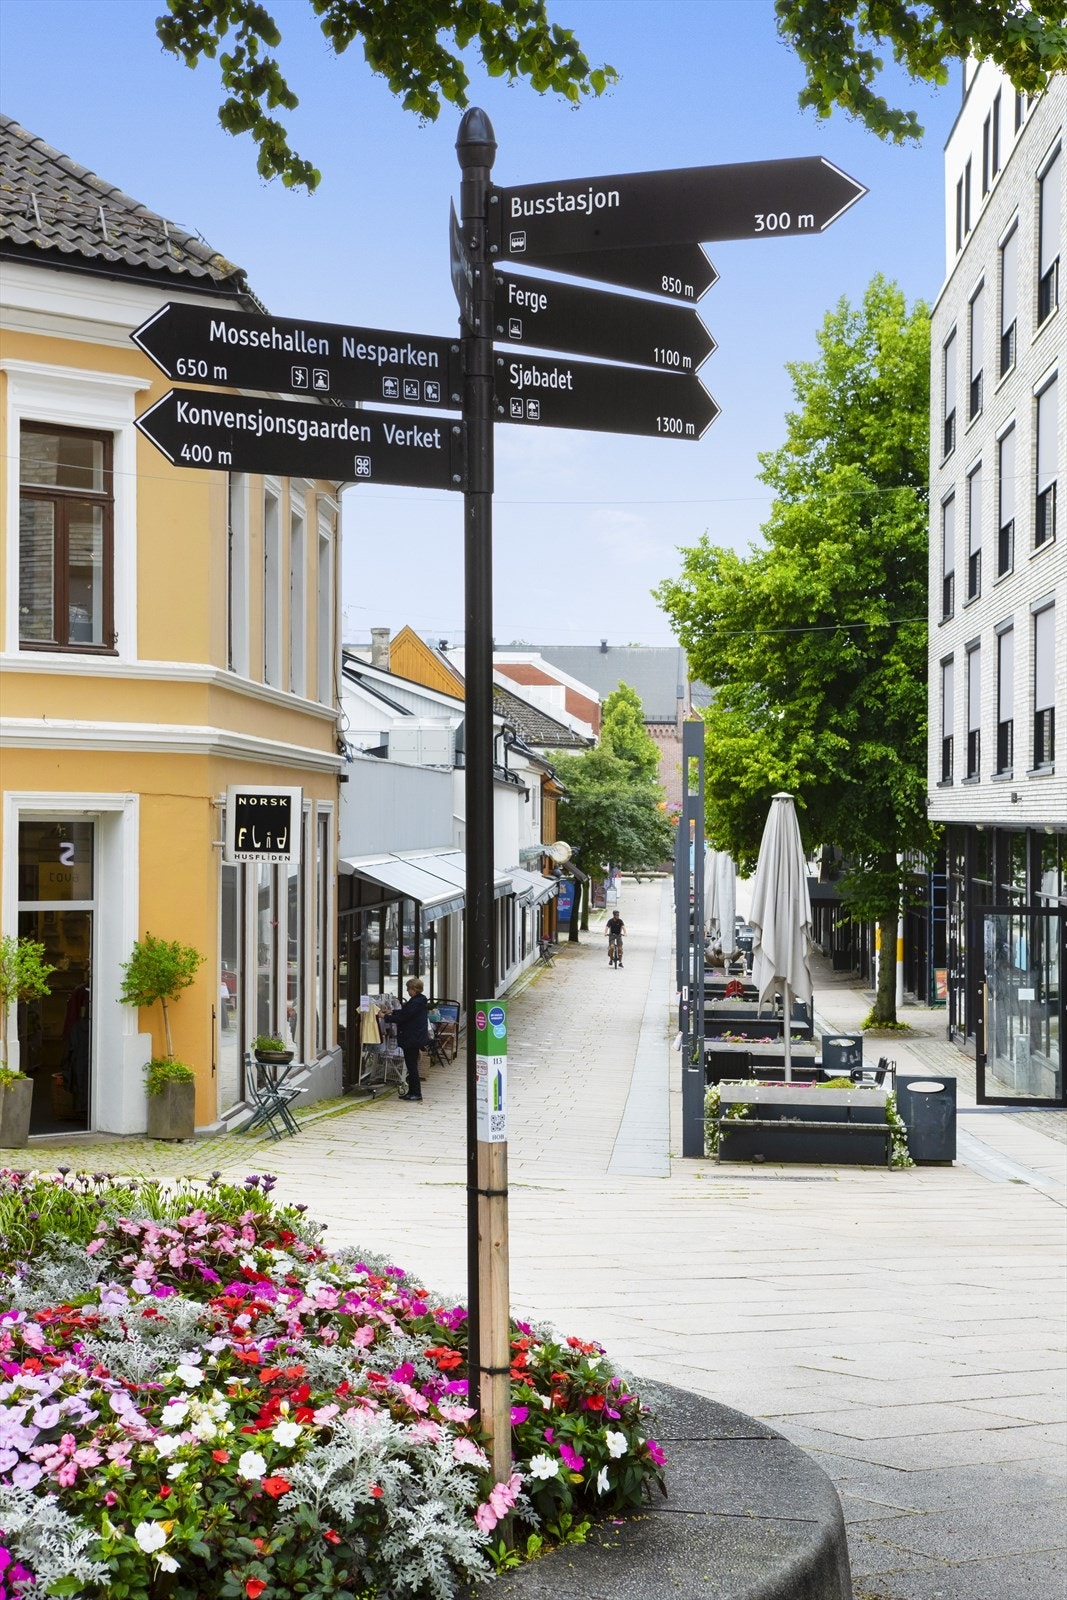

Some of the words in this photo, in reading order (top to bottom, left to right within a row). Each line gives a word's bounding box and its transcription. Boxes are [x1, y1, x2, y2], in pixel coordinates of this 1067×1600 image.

[510, 188, 620, 217] Busstasjon
[754, 212, 791, 232] 300
[798, 213, 815, 228] m
[661, 275, 682, 294] 850
[684, 284, 695, 297] m
[508, 284, 548, 313] Ferge
[209, 320, 330, 356] Mossehallen
[342, 336, 439, 367] Nesparken
[176, 357, 208, 378] 650
[213, 366, 228, 380] m
[653, 347, 680, 369] 1100
[682, 356, 692, 369] m
[509, 364, 574, 391] Sjøbadet
[176, 401, 371, 442] Konvensjonsgaarden
[383, 423, 441, 449] Verket
[656, 417, 682, 434] 1300
[684, 424, 695, 436] m
[180, 443, 213, 463] 400
[217, 450, 232, 465] m
[239, 797, 287, 806] NORSK
